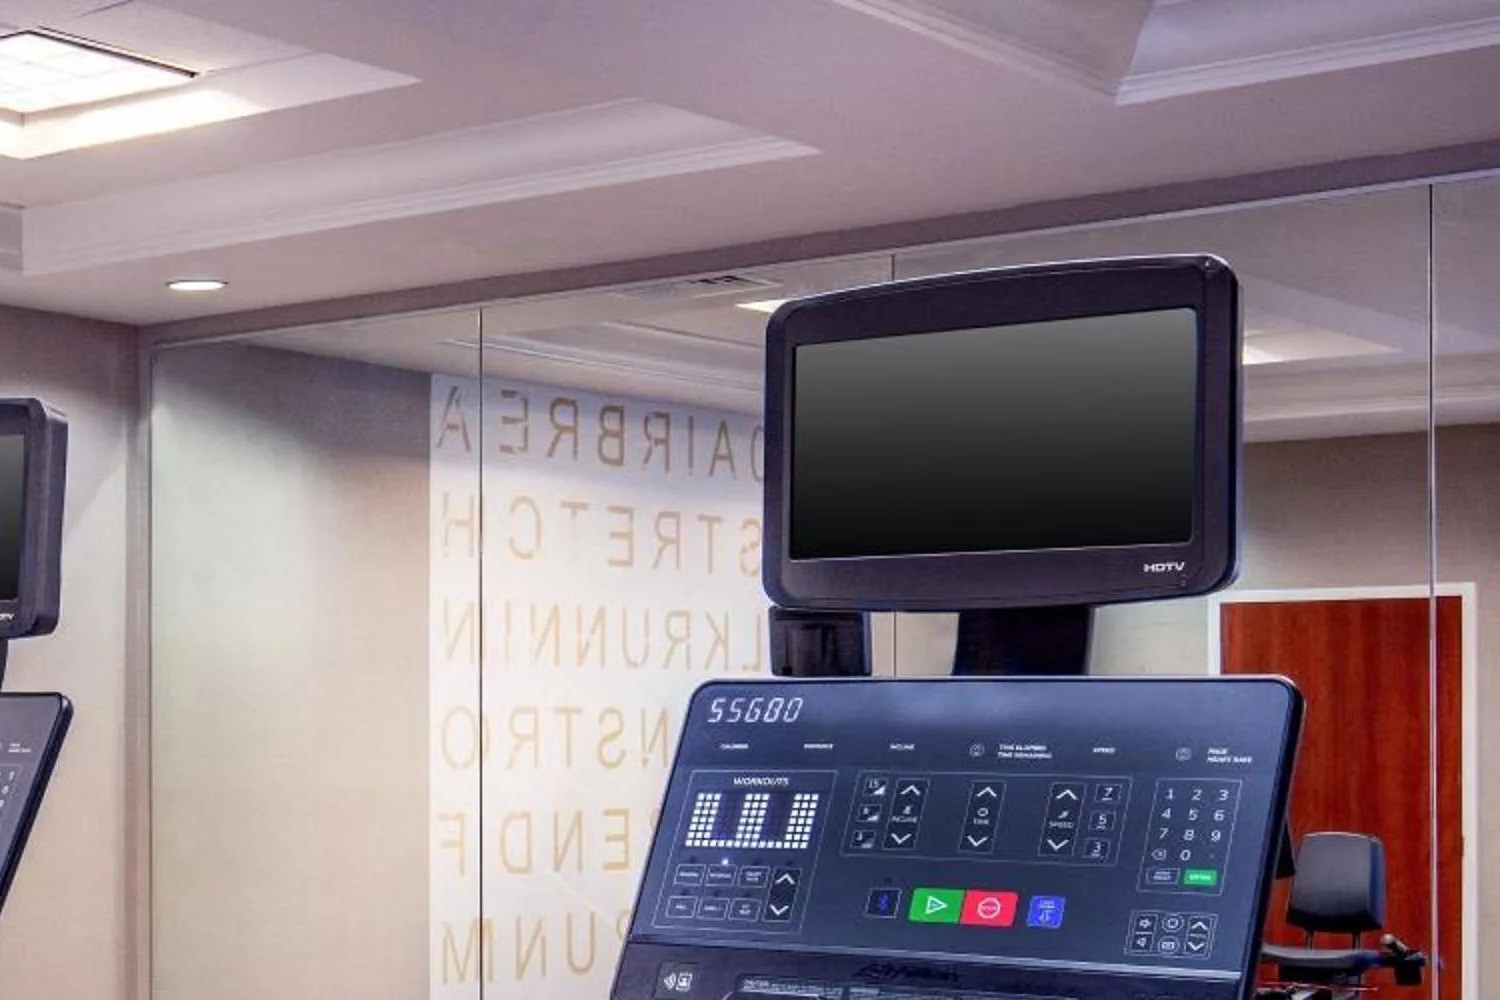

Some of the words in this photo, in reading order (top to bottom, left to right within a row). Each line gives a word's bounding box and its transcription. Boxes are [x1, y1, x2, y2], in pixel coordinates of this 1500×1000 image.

[1143, 561, 1186, 573] HDTV
[1191, 788, 1203, 801] 2
[1219, 788, 1229, 801] 3
[1160, 807, 1171, 820] 4
[1187, 808, 1198, 821] 5
[1213, 808, 1226, 822] 6
[1158, 827, 1169, 840] 7
[1183, 828, 1195, 842] 8
[1211, 828, 1222, 842] 9
[1179, 849, 1192, 862] 0
